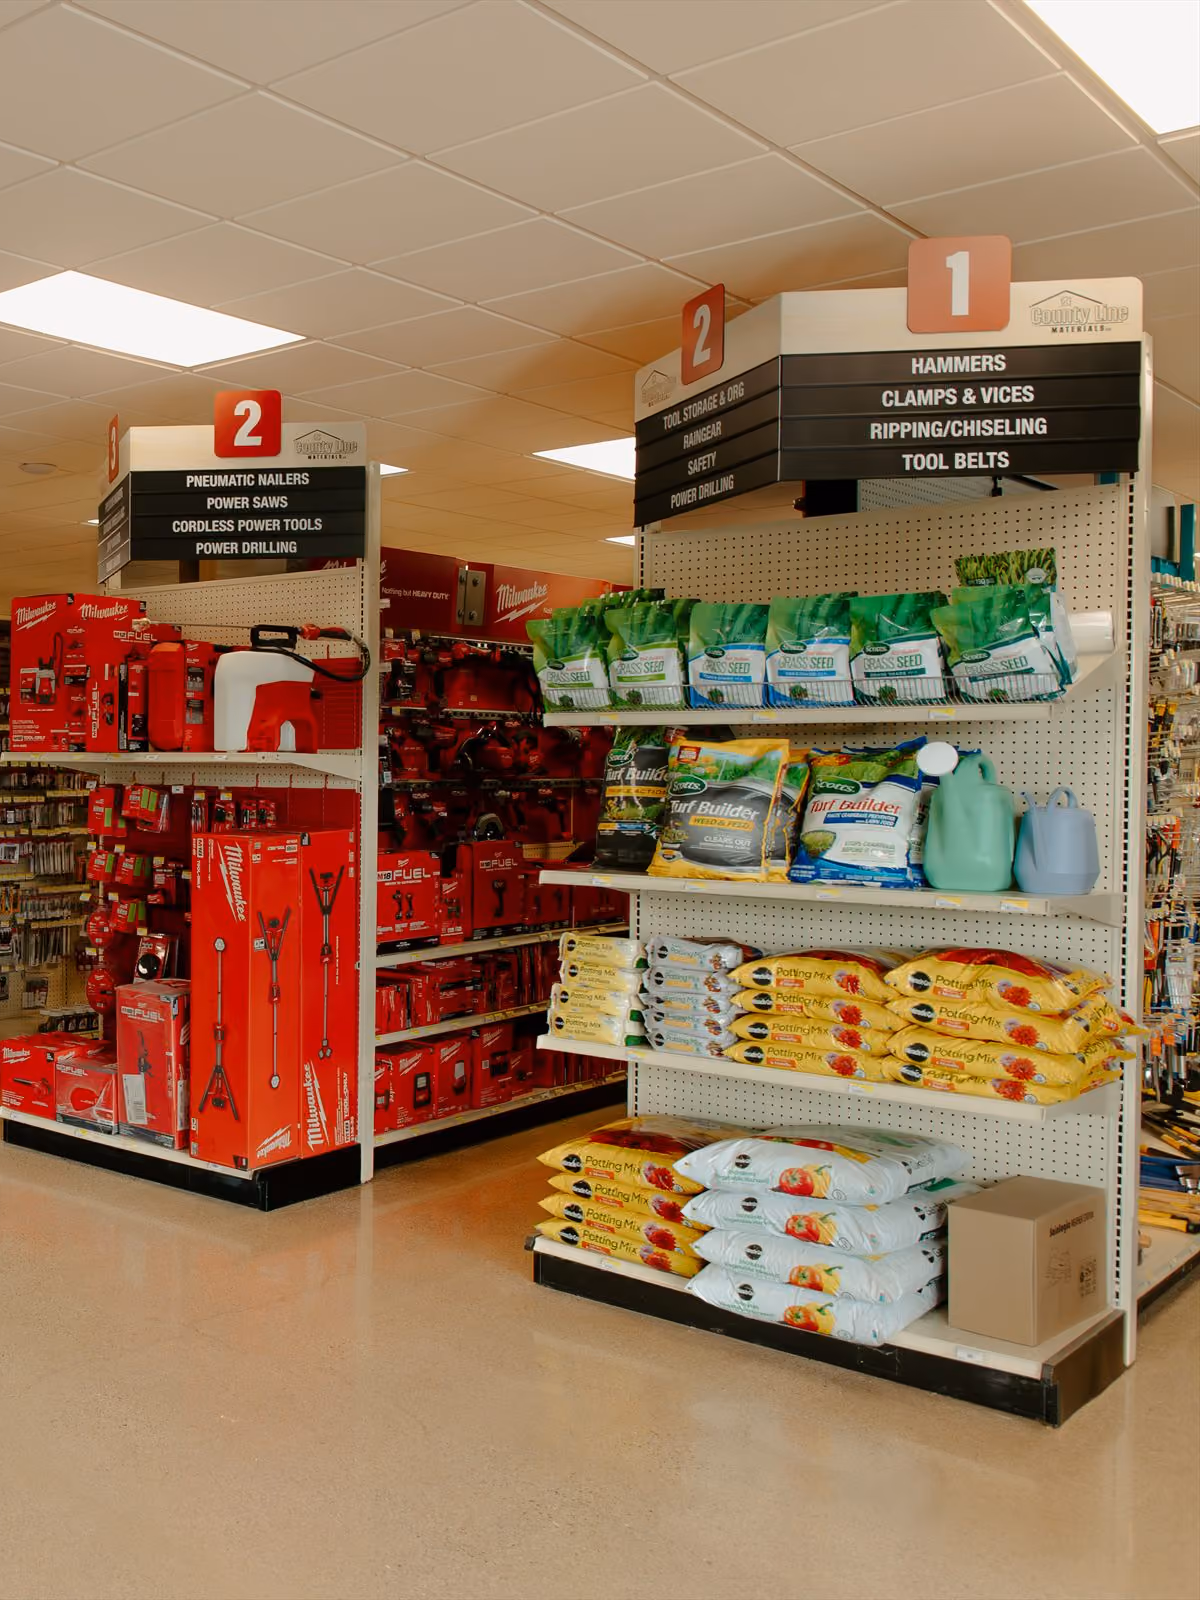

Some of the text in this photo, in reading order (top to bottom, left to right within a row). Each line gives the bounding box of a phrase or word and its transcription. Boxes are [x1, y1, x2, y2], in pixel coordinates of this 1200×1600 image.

[945, 251, 970, 316] 1
[1031, 303, 1129, 325] County Line
[692, 303, 711, 368] 2
[1051, 324, 1105, 334] MATERIALS
[911, 354, 1006, 375] HAMMERS
[881, 385, 1035, 408] CLAMPS & VICES
[663, 381, 745, 431] TOOL STORAGE & ORG
[233, 399, 263, 447] 2
[870, 417, 1048, 440] RIPPING/CHISELING
[683, 420, 722, 450] RAINGEAR
[687, 451, 717, 476] SAFETY
[902, 451, 1010, 471] TOOL BELTS
[186, 472, 310, 488] PNEUMATIC NAILERS
[670, 473, 735, 510] POWER DRILLING
[206, 496, 288, 510] POWER SAWS
[172, 518, 323, 533] CORDLESS POWER TOOLS
[196, 540, 297, 555] POWER DRILLING
[382, 586, 449, 600] Nothing but HEAVY DUTY
[496, 581, 548, 612] Milwaukee
[15, 601, 57, 625] Milwaukee
[78, 602, 129, 621] Milwaukee
[127, 631, 158, 642] FUEL
[643, 660, 665, 674] SEED
[728, 662, 751, 674] SEED
[809, 656, 834, 669] SEED
[863, 654, 922, 671] GRASS SEED
[965, 656, 1028, 676] GRASS SEED
[571, 670, 591, 682] SEED
[672, 780, 701, 791] Scotts
[816, 778, 855, 793] Scotts
[670, 800, 760, 820] Turf Builder
[810, 797, 902, 815] Turf Builder
[491, 858, 518, 867] FUEL
[224, 840, 247, 922] Milwaukee
[393, 868, 431, 880] FUEL
[776, 967, 832, 981] Potting Mix
[975, 978, 994, 989] Mix
[776, 992, 831, 1009] Potting Mix
[566, 1018, 588, 1028] Potting
[939, 1006, 980, 1024] Potting
[982, 1015, 1002, 1028] Mix
[772, 1022, 829, 1036] Potting Mix
[767, 1047, 823, 1062] Potting Mix
[933, 1046, 997, 1064] Potting Mix
[965, 1075, 987, 1085] Mix
[303, 1062, 325, 1152] Milwaukee
[585, 1155, 622, 1172] Potting
[623, 1162, 640, 1175] Mix
[594, 1183, 631, 1202] Potting
[631, 1192, 649, 1206] Mix
[586, 1207, 622, 1229] Potting
[623, 1219, 641, 1233] Mix
[582, 1229, 618, 1251] Potting
[619, 1241, 638, 1254] Mix
